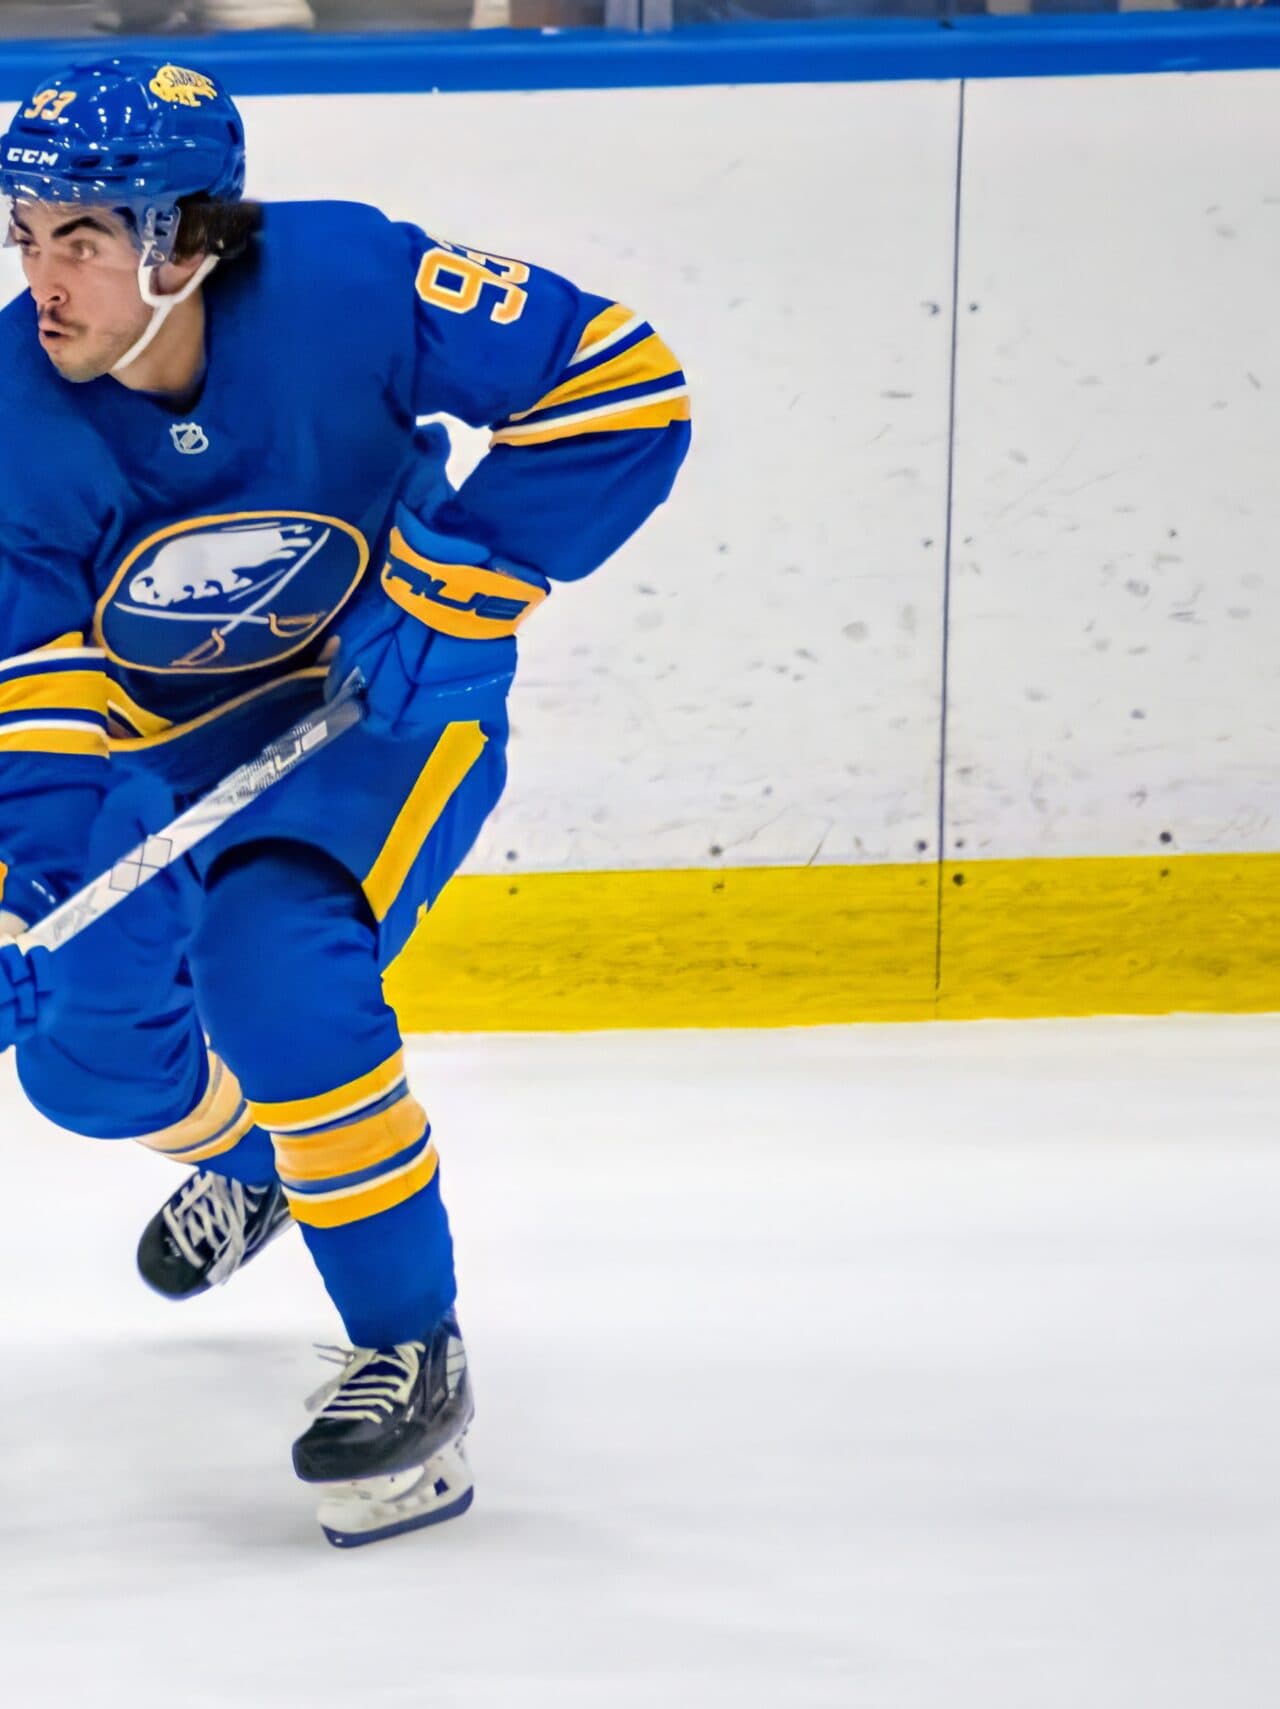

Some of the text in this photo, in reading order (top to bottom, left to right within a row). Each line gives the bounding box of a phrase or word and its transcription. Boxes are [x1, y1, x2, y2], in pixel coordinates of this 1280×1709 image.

[24, 88, 77, 120] 93
[7, 147, 59, 167] CCM
[414, 237, 530, 324] 93
